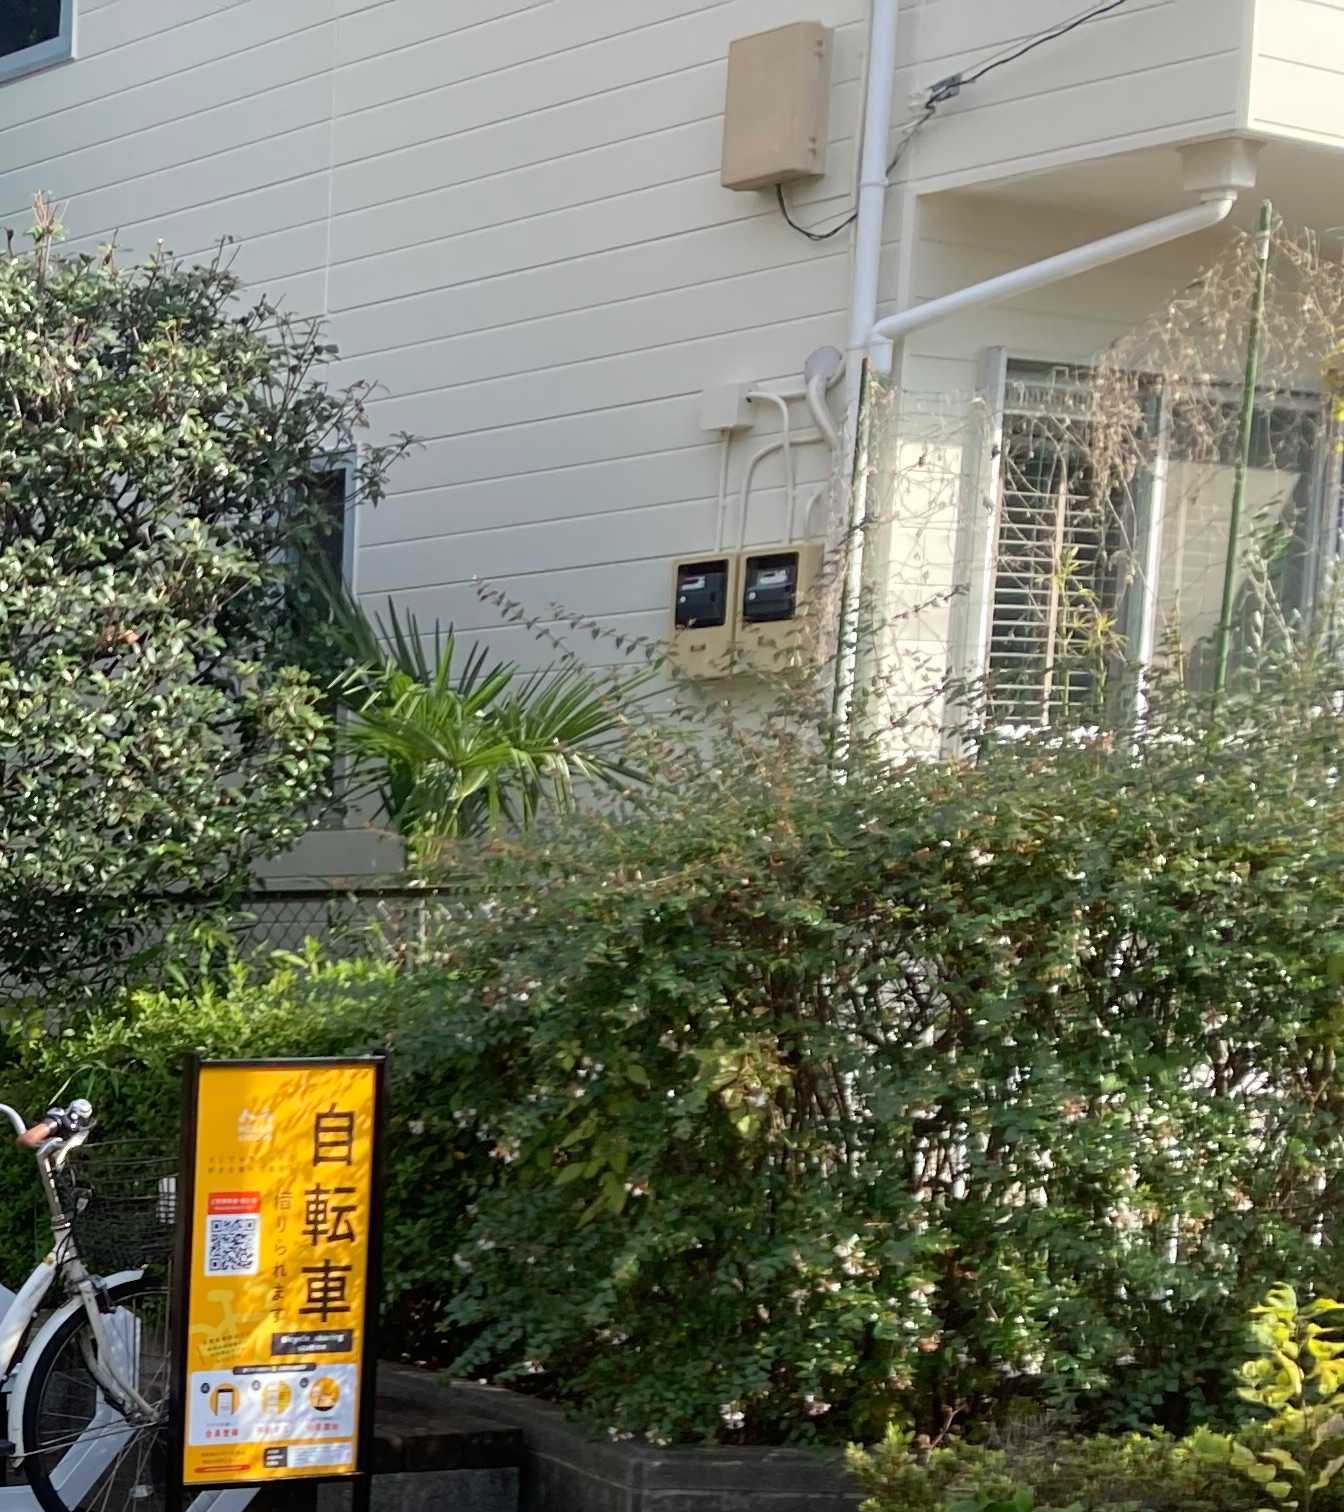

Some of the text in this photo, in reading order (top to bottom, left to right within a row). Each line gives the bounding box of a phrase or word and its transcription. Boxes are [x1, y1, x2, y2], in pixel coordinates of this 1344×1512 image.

[271, 1190, 293, 1322] 借りられます
[299, 1103, 357, 1322] 自転車
